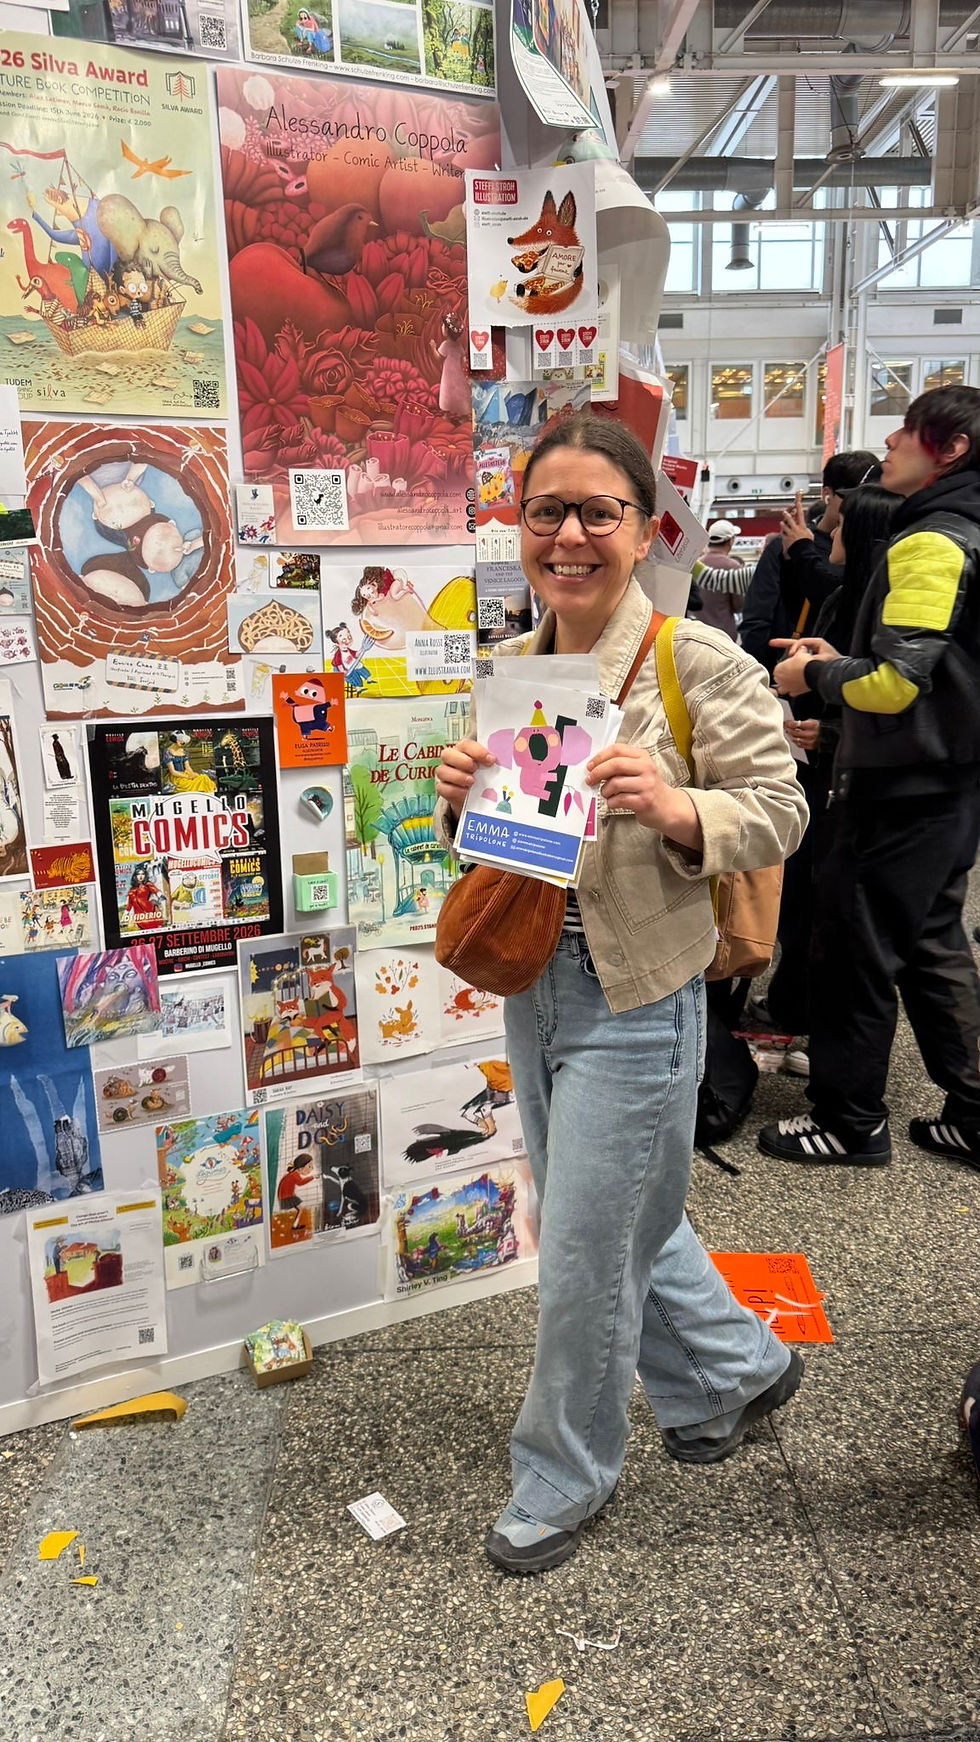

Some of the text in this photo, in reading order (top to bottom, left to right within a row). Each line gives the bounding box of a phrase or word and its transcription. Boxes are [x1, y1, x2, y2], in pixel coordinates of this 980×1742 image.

[0, 49, 149, 87] 26 Silva Award
[251, 51, 277, 62] Barbara
[277, 56, 302, 65] Schulze
[302, 59, 329, 70] Frenking
[36, 78, 67, 94] BOOK
[71, 83, 151, 107] COMPETITION
[161, 103, 203, 116] SILVA AWARD
[266, 105, 467, 159] Alessandro Coppola
[266, 142, 328, 162] Illustrator
[344, 152, 380, 168] Comic
[385, 156, 418, 174] Artist
[432, 164, 464, 179] Writer
[474, 192, 516, 203] ILLUSTRATION
[552, 252, 577, 261] AMORE
[5, 378, 32, 387] TUDEM
[36, 383, 66, 400] silva
[415, 637, 428, 647] ANNA
[378, 744, 399, 763] LE
[370, 769, 390, 783] DE
[132, 796, 246, 819] MUGELLO
[133, 812, 248, 855] COMICS
[467, 819, 510, 839] EMMA
[230, 861, 261, 874] COMICS
[166, 928, 231, 948] SETTEMBRE
[233, 924, 261, 940] 2026
[164, 942, 233, 958] BARBERINO DI MUGELLO
[296, 1101, 344, 1126] DAISY
[311, 1118, 329, 1129] and
[396, 1282, 423, 1293] Shirley
[432, 1274, 448, 1284] Ting
